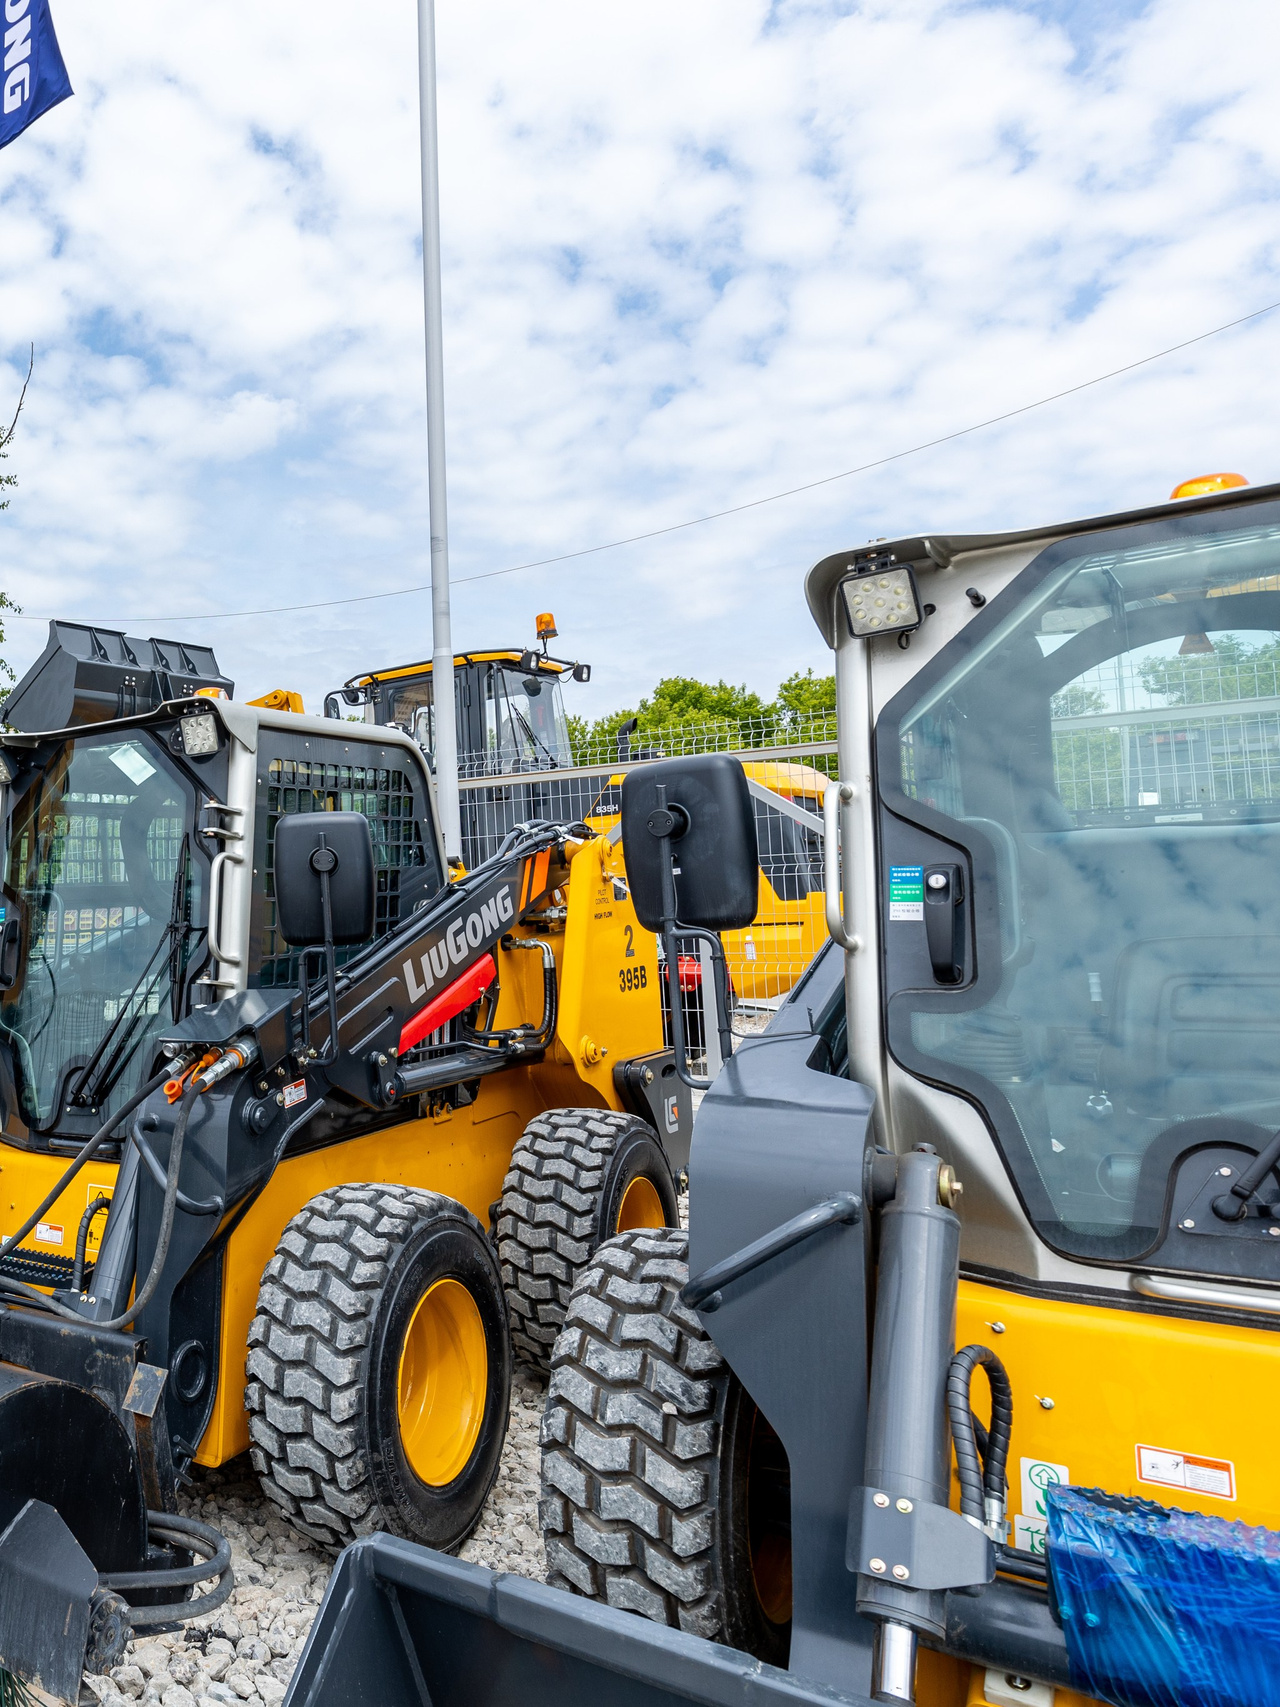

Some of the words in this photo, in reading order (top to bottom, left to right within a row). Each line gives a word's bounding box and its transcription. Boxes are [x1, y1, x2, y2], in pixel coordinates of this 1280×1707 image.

[596, 804, 618, 813] 835H
[402, 884, 514, 1004] LIUGONG
[624, 924, 635, 951] 2
[619, 965, 648, 993] 395B
